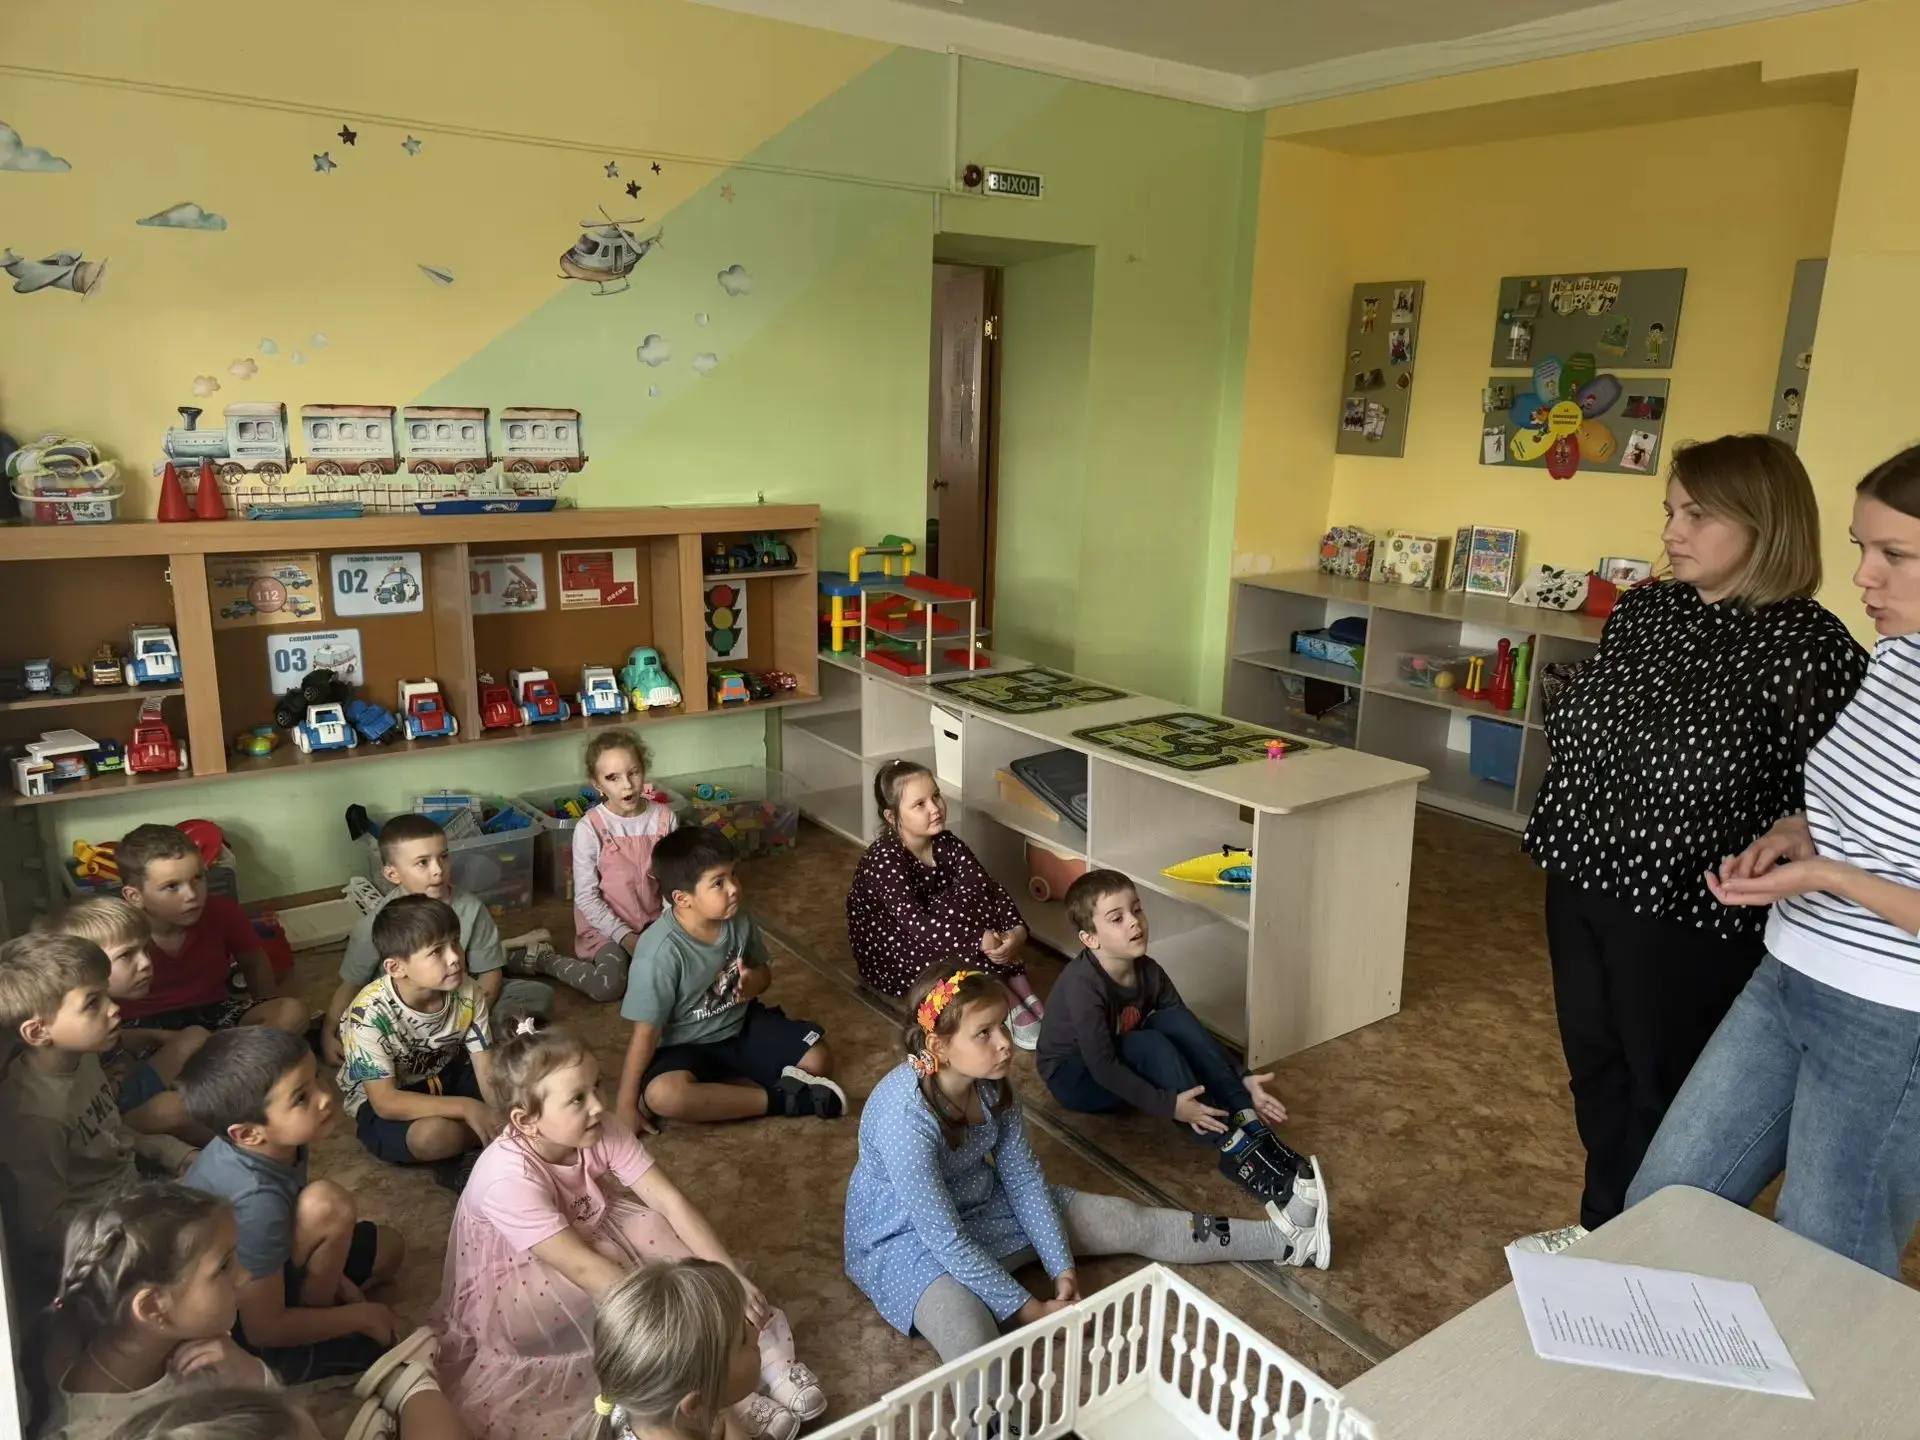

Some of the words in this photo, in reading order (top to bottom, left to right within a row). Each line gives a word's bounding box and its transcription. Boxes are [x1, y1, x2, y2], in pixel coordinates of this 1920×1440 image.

[989, 173, 1037, 195] ВЫХОД
[338, 568, 368, 594] 02
[256, 590, 280, 601] 112
[274, 647, 307, 673] 03
